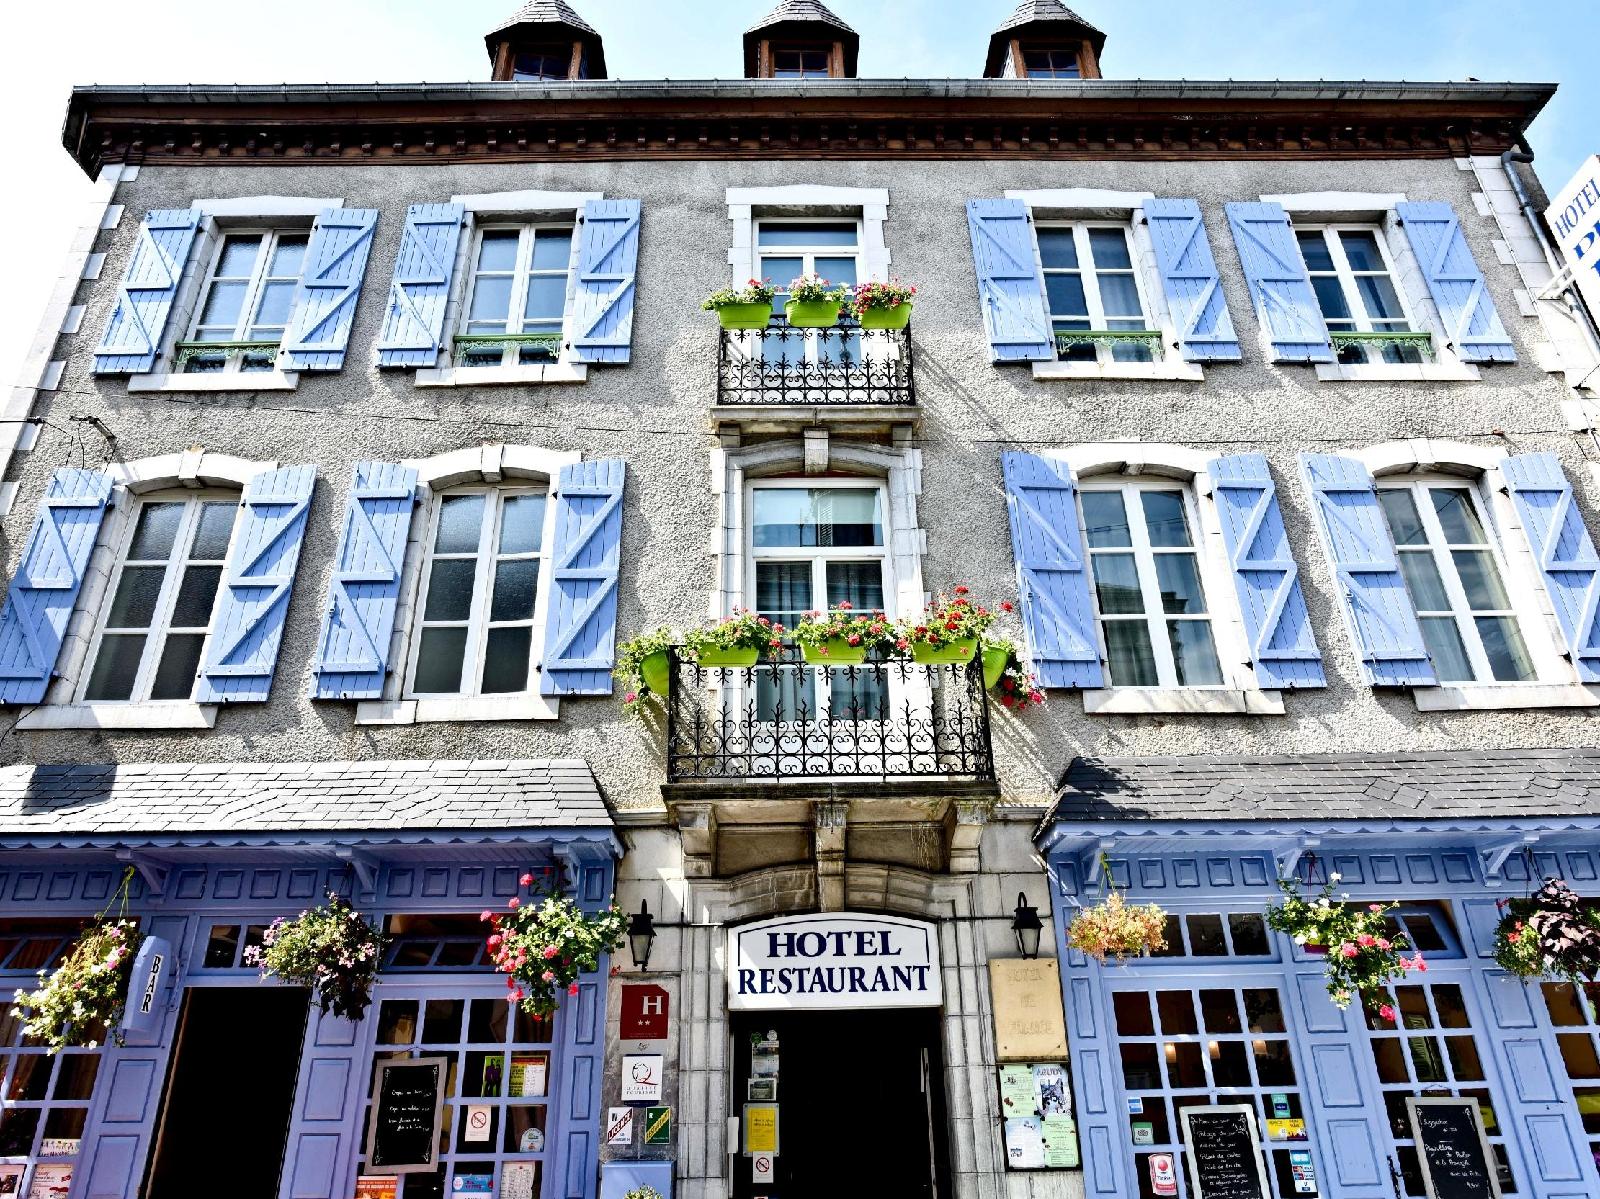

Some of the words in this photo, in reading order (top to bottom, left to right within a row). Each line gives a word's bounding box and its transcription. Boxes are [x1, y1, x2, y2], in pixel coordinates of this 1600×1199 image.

[767, 931, 902, 957] HOTEL
[143, 955, 161, 1012] BAR
[738, 965, 930, 994] RESTAURANT
[642, 995, 663, 1015] H
[608, 1111, 632, 1141] LICENCE
